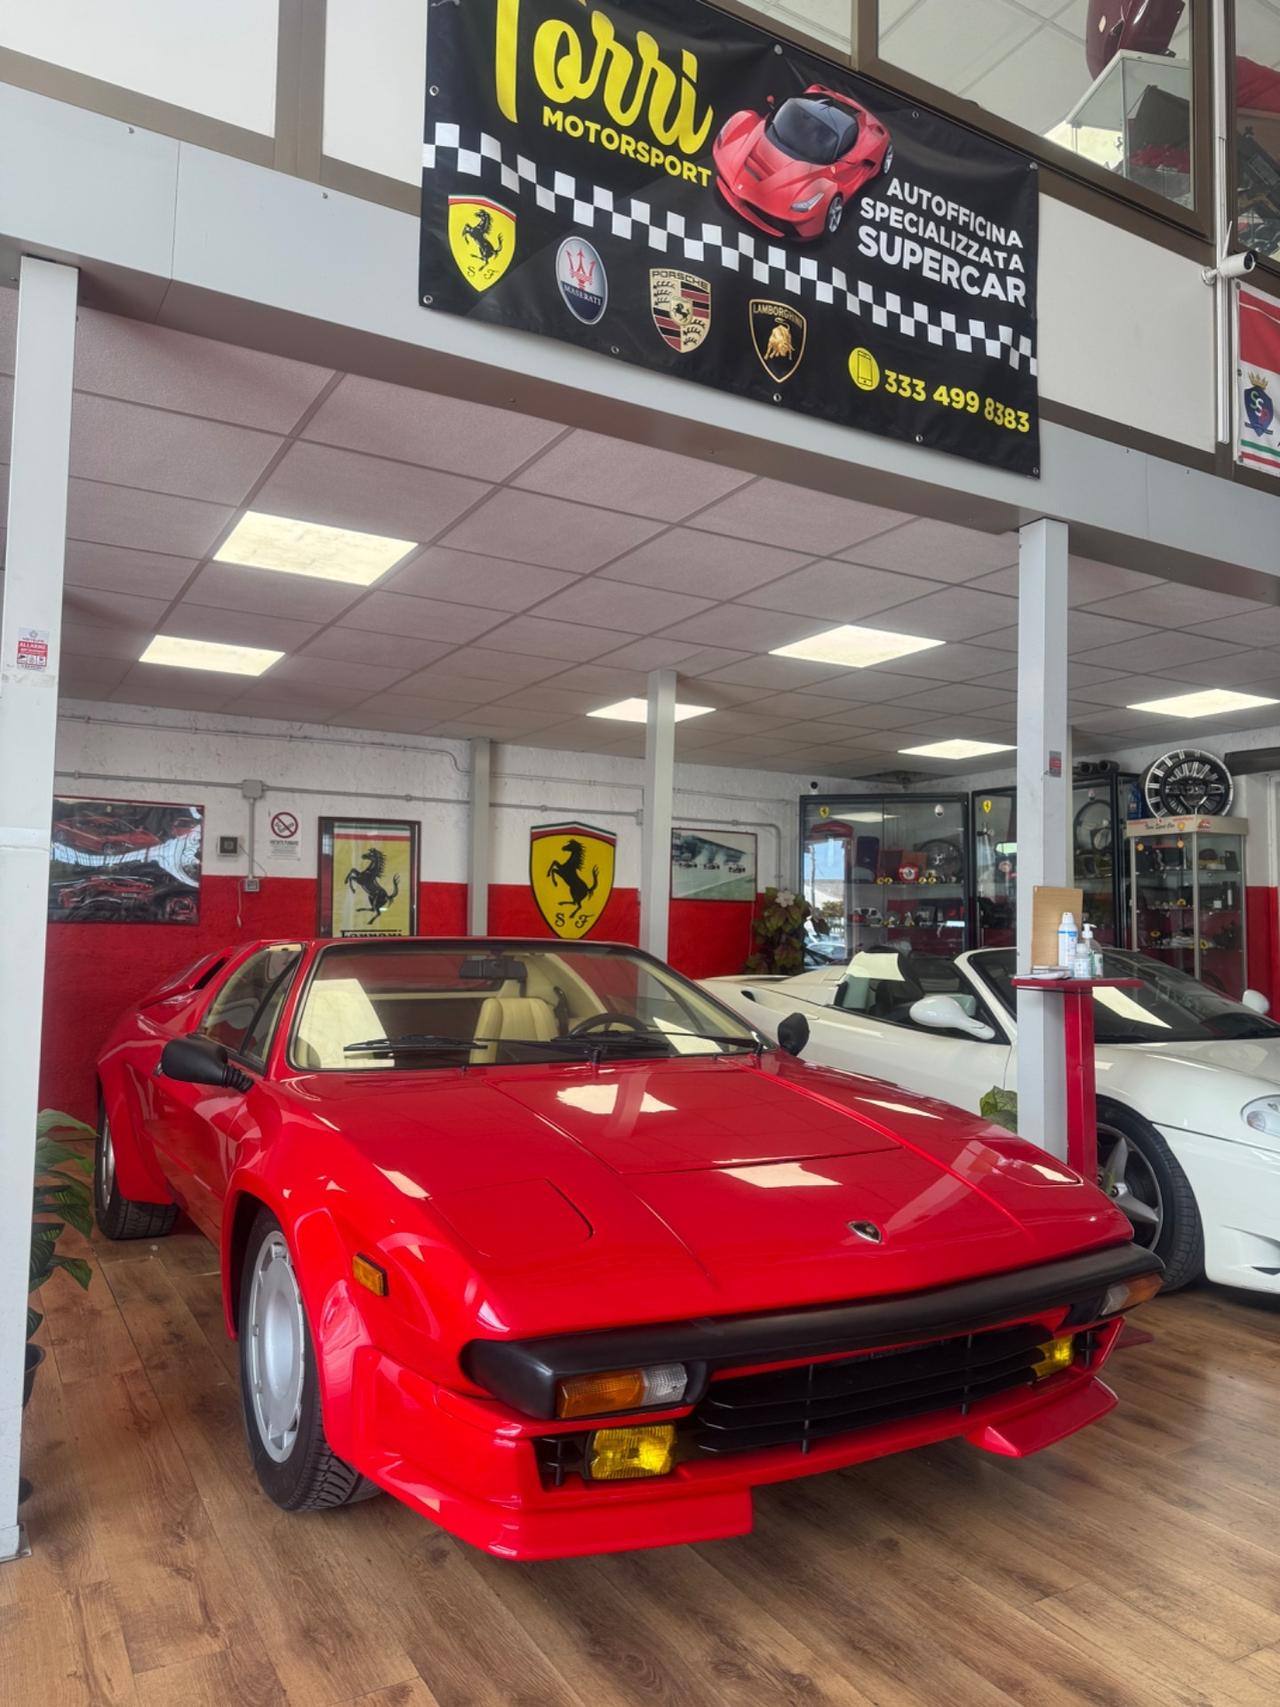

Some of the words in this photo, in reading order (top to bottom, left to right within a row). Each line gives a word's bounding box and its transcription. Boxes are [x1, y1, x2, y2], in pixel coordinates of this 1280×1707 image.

[542, 105, 712, 188] MOTORSPORT
[859, 196, 1025, 273] SPECIALIZZATA
[886, 177, 1024, 249] AUTOFFICINA
[563, 284, 602, 306] MASERATI
[652, 270, 709, 289] PORSCHE
[857, 225, 1027, 308] SUPERCAR
[753, 303, 803, 329] LAMBORGHINI
[884, 369, 927, 402] 333
[932, 385, 980, 414] 499
[984, 397, 1030, 433] 8383
[555, 912, 565, 928] S
[575, 914, 595, 929] F
